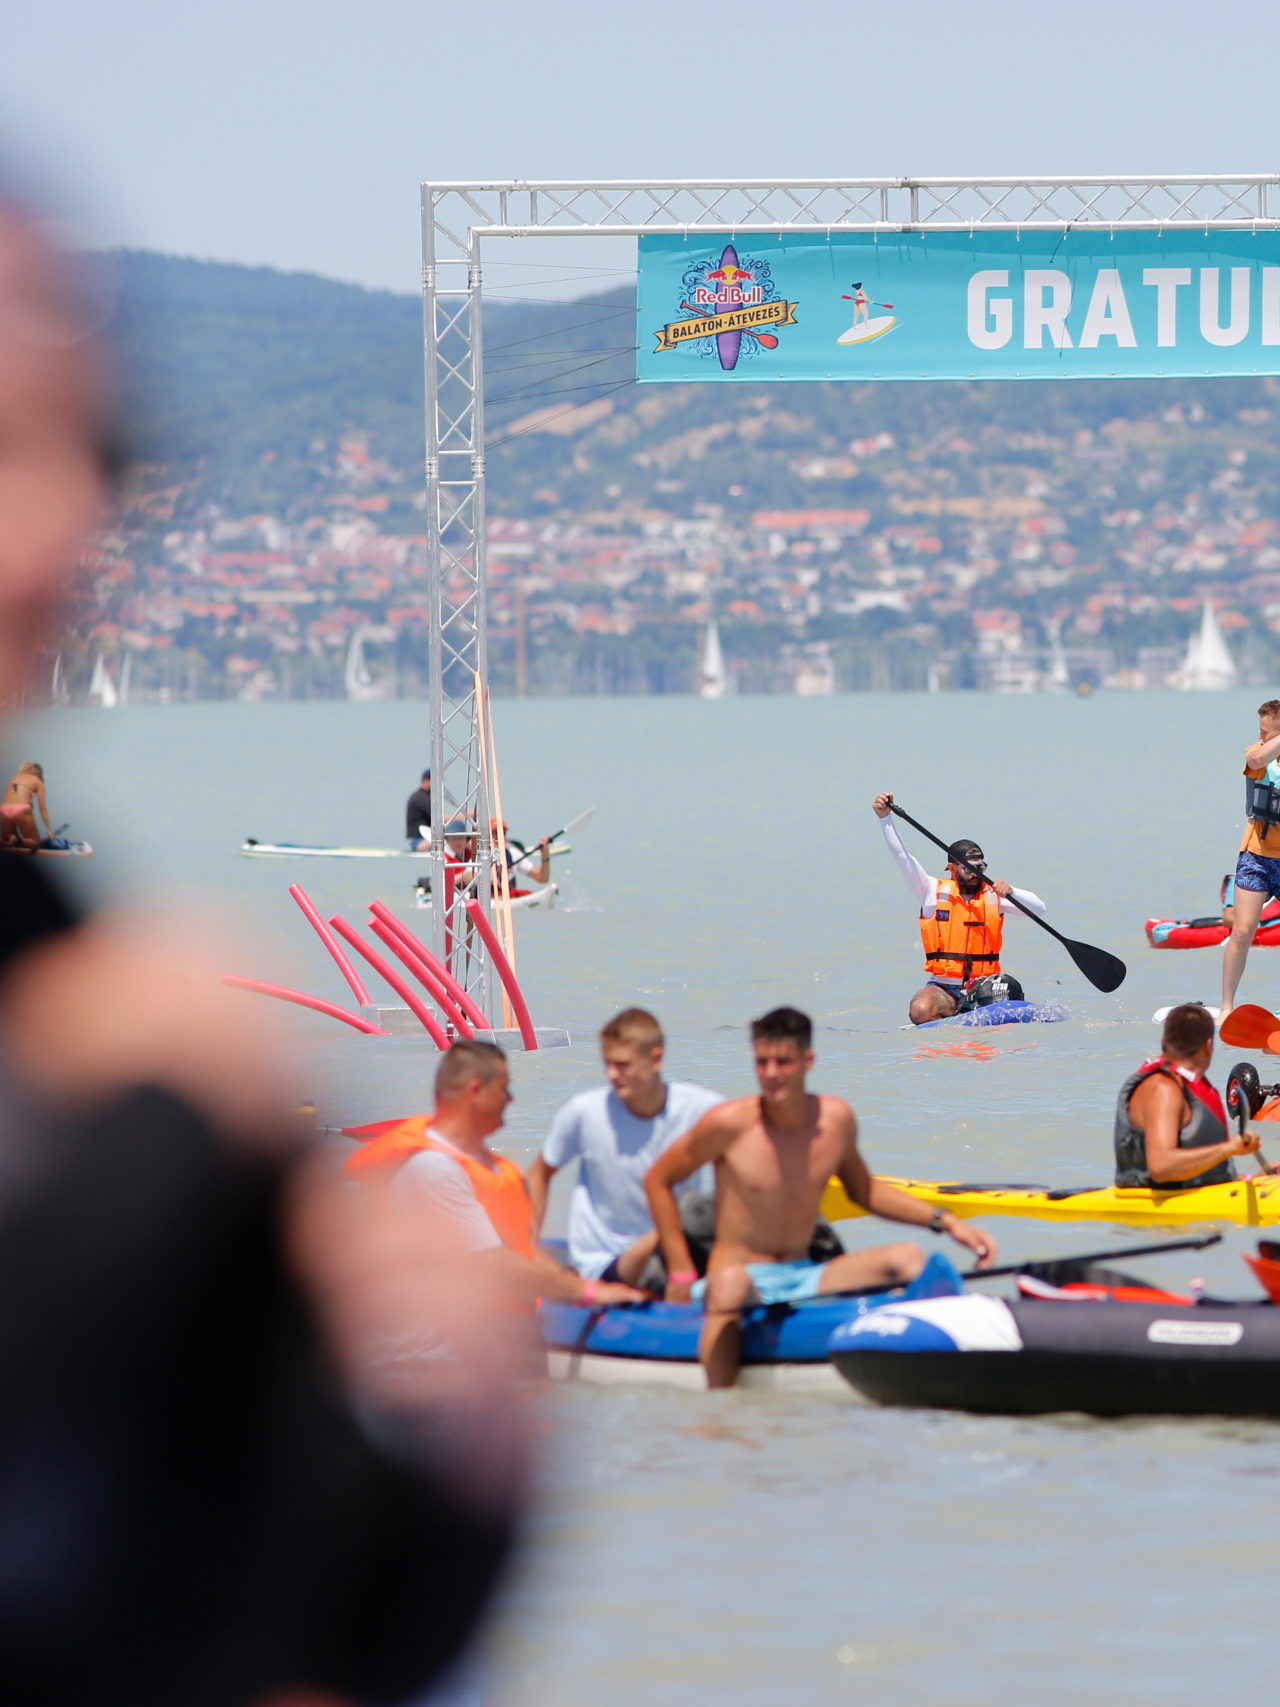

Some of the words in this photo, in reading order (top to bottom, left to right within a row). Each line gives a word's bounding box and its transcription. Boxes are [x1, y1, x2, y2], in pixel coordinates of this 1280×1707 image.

[696, 287, 728, 303] Red
[730, 286, 761, 303] Bull
[673, 305, 781, 339] BALATON-ÁTEVEZÉS
